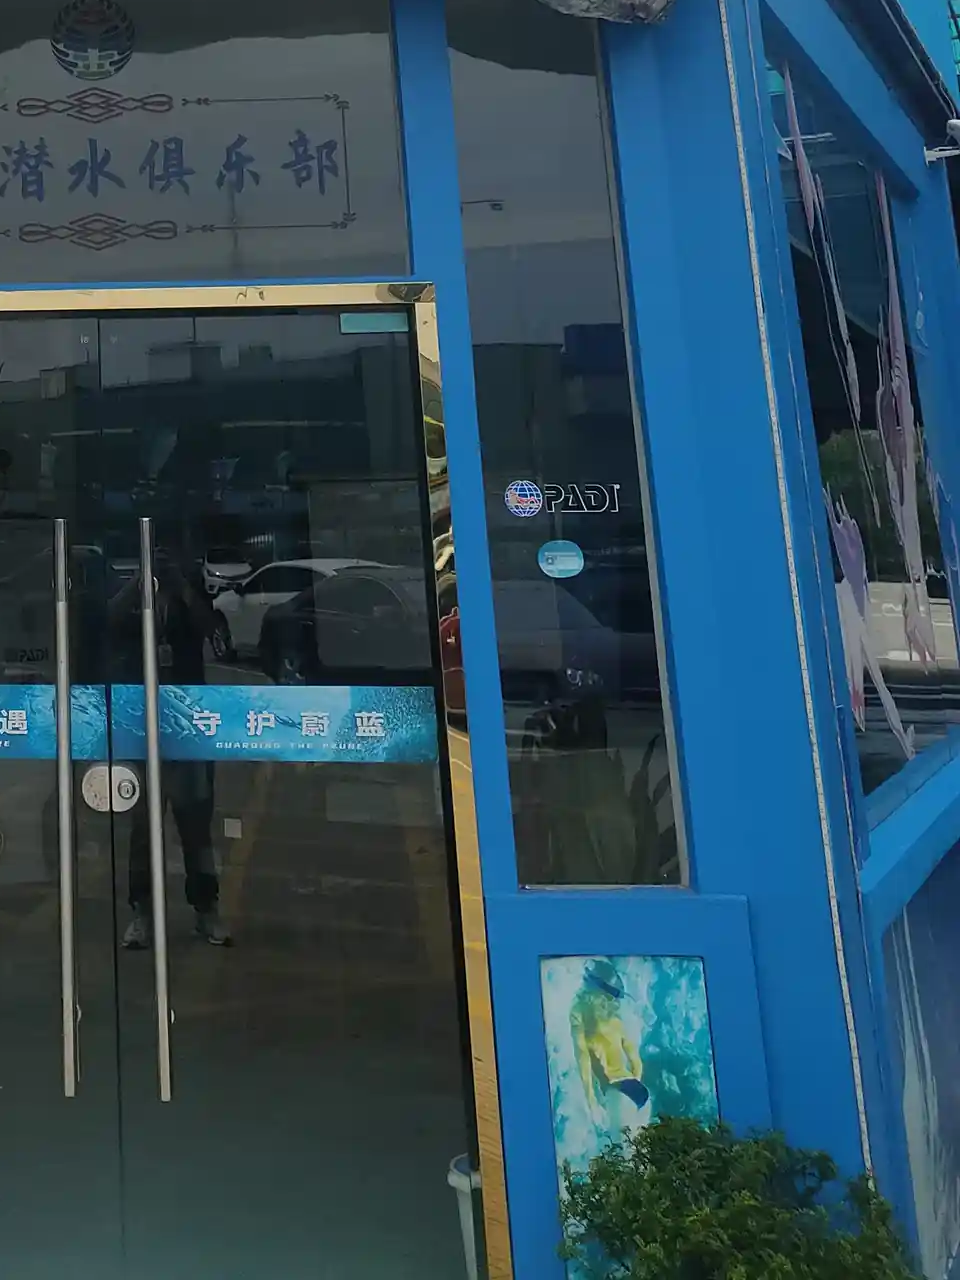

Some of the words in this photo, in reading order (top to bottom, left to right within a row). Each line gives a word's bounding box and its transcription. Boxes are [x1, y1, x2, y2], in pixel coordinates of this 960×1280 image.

[544, 483, 620, 513] PADI
[192, 710, 386, 737] 守护蔚蓝
